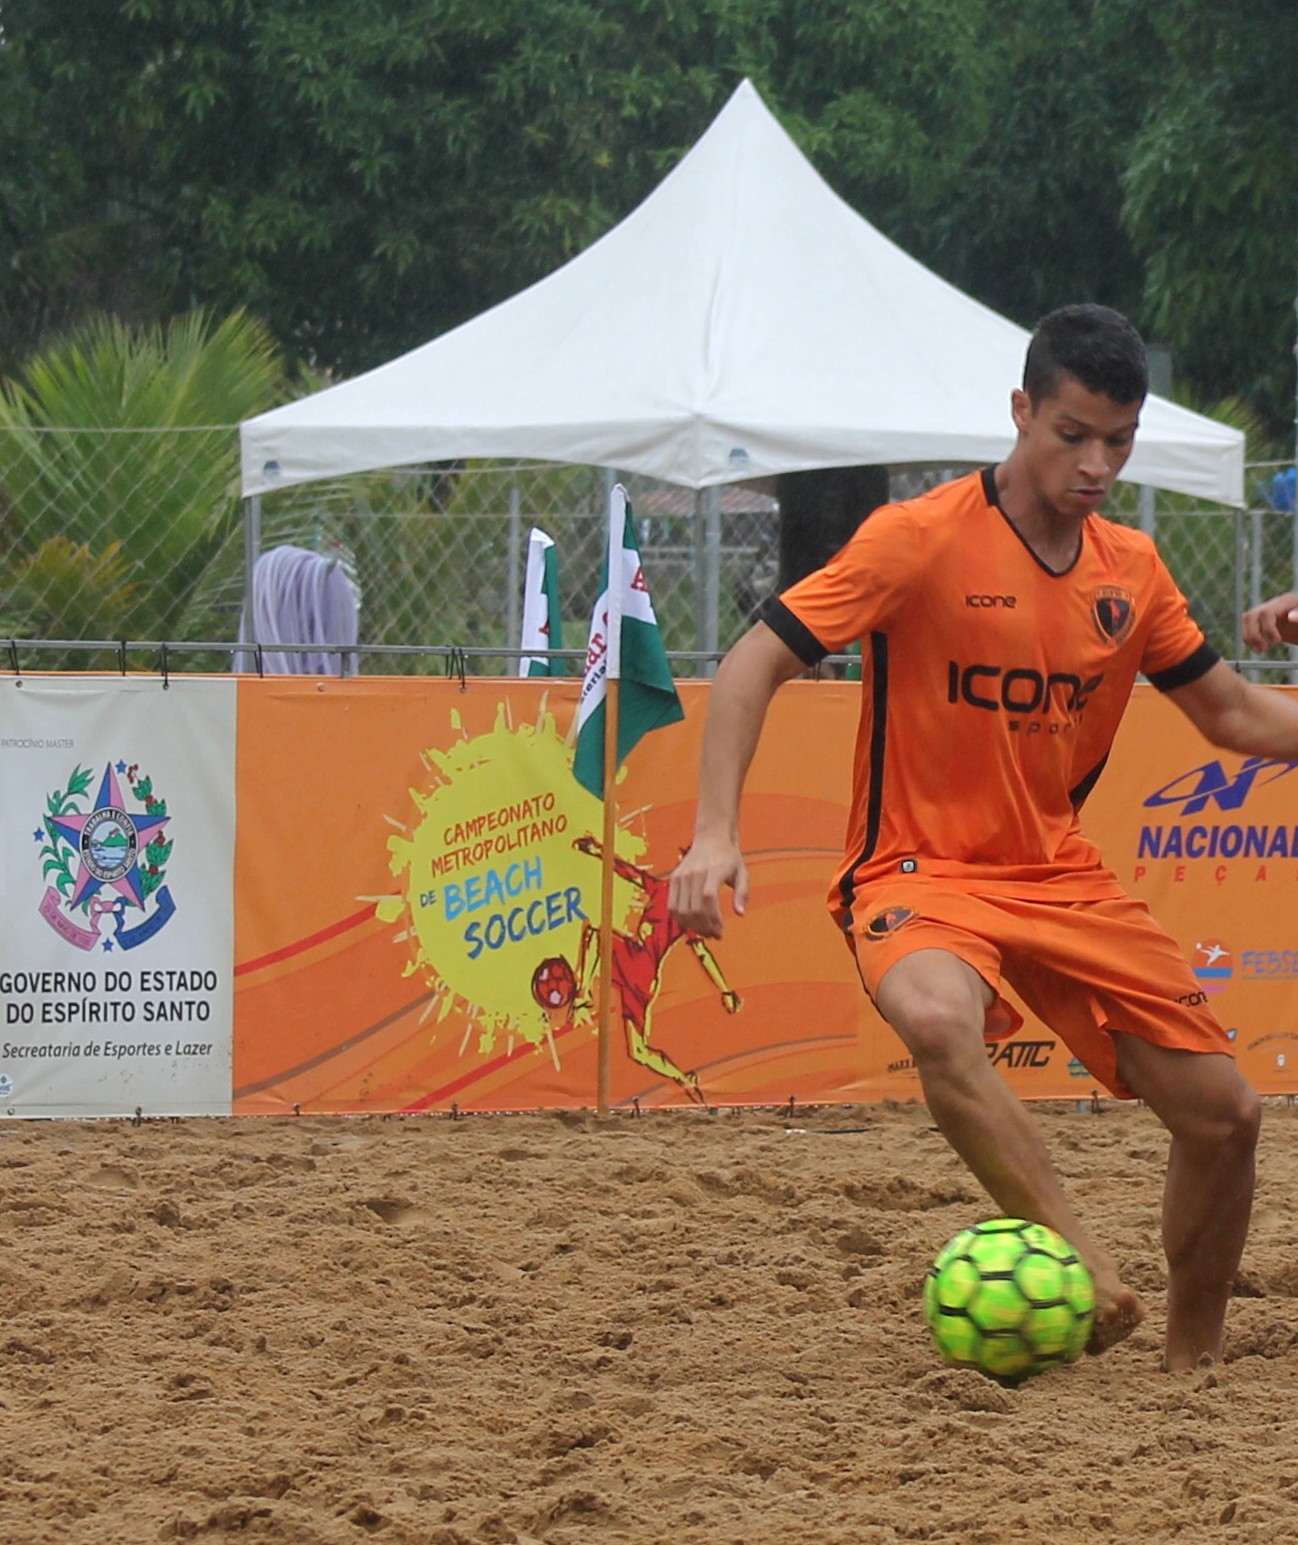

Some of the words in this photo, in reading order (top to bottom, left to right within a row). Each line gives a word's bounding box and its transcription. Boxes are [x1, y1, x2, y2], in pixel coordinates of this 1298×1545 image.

[431, 813, 568, 879] METROPOLITANO
[443, 791, 556, 847] CAMPEONATO
[420, 890, 437, 908] DE
[442, 855, 543, 922] BEACH
[464, 886, 590, 960] SOCCER
[0, 972, 97, 993] GOVERNO
[105, 971, 132, 992] DO
[140, 970, 218, 992] ESTADO
[6, 1003, 34, 1024] DO
[41, 997, 136, 1023] ESPÍRITO
[143, 1001, 210, 1022] SANTO
[2, 1042, 80, 1058] Secreataria
[85, 1041, 100, 1057] de
[103, 1041, 161, 1060] Esportes
[164, 1045, 172, 1056] e
[175, 1040, 213, 1056] Lazer
